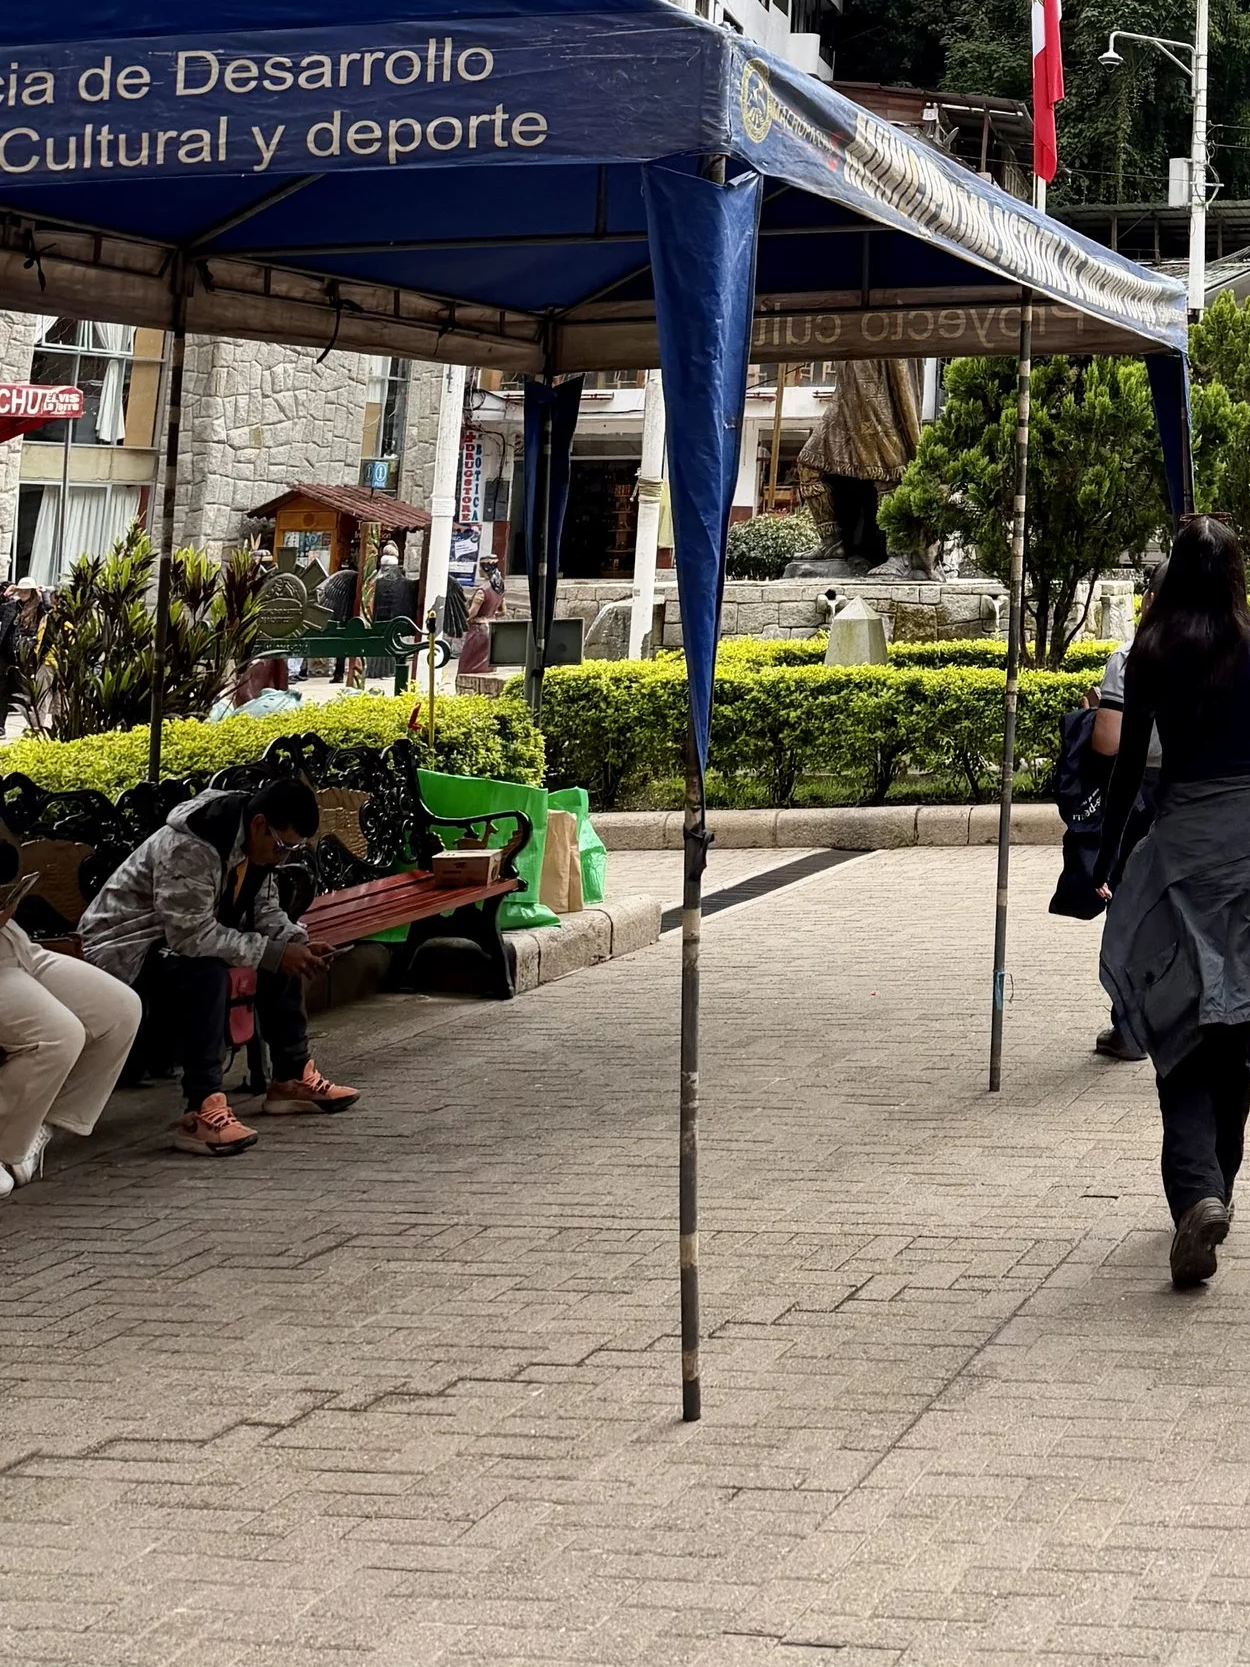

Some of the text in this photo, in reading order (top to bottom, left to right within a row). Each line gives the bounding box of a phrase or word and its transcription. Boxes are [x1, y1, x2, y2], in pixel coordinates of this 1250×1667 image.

[78, 55, 151, 102] de
[176, 37, 494, 96] Desarrollo
[0, 103, 548, 174] Cultural y deporte
[461, 443, 475, 522] DRUGSTORE
[472, 444, 483, 521] BOTICA
